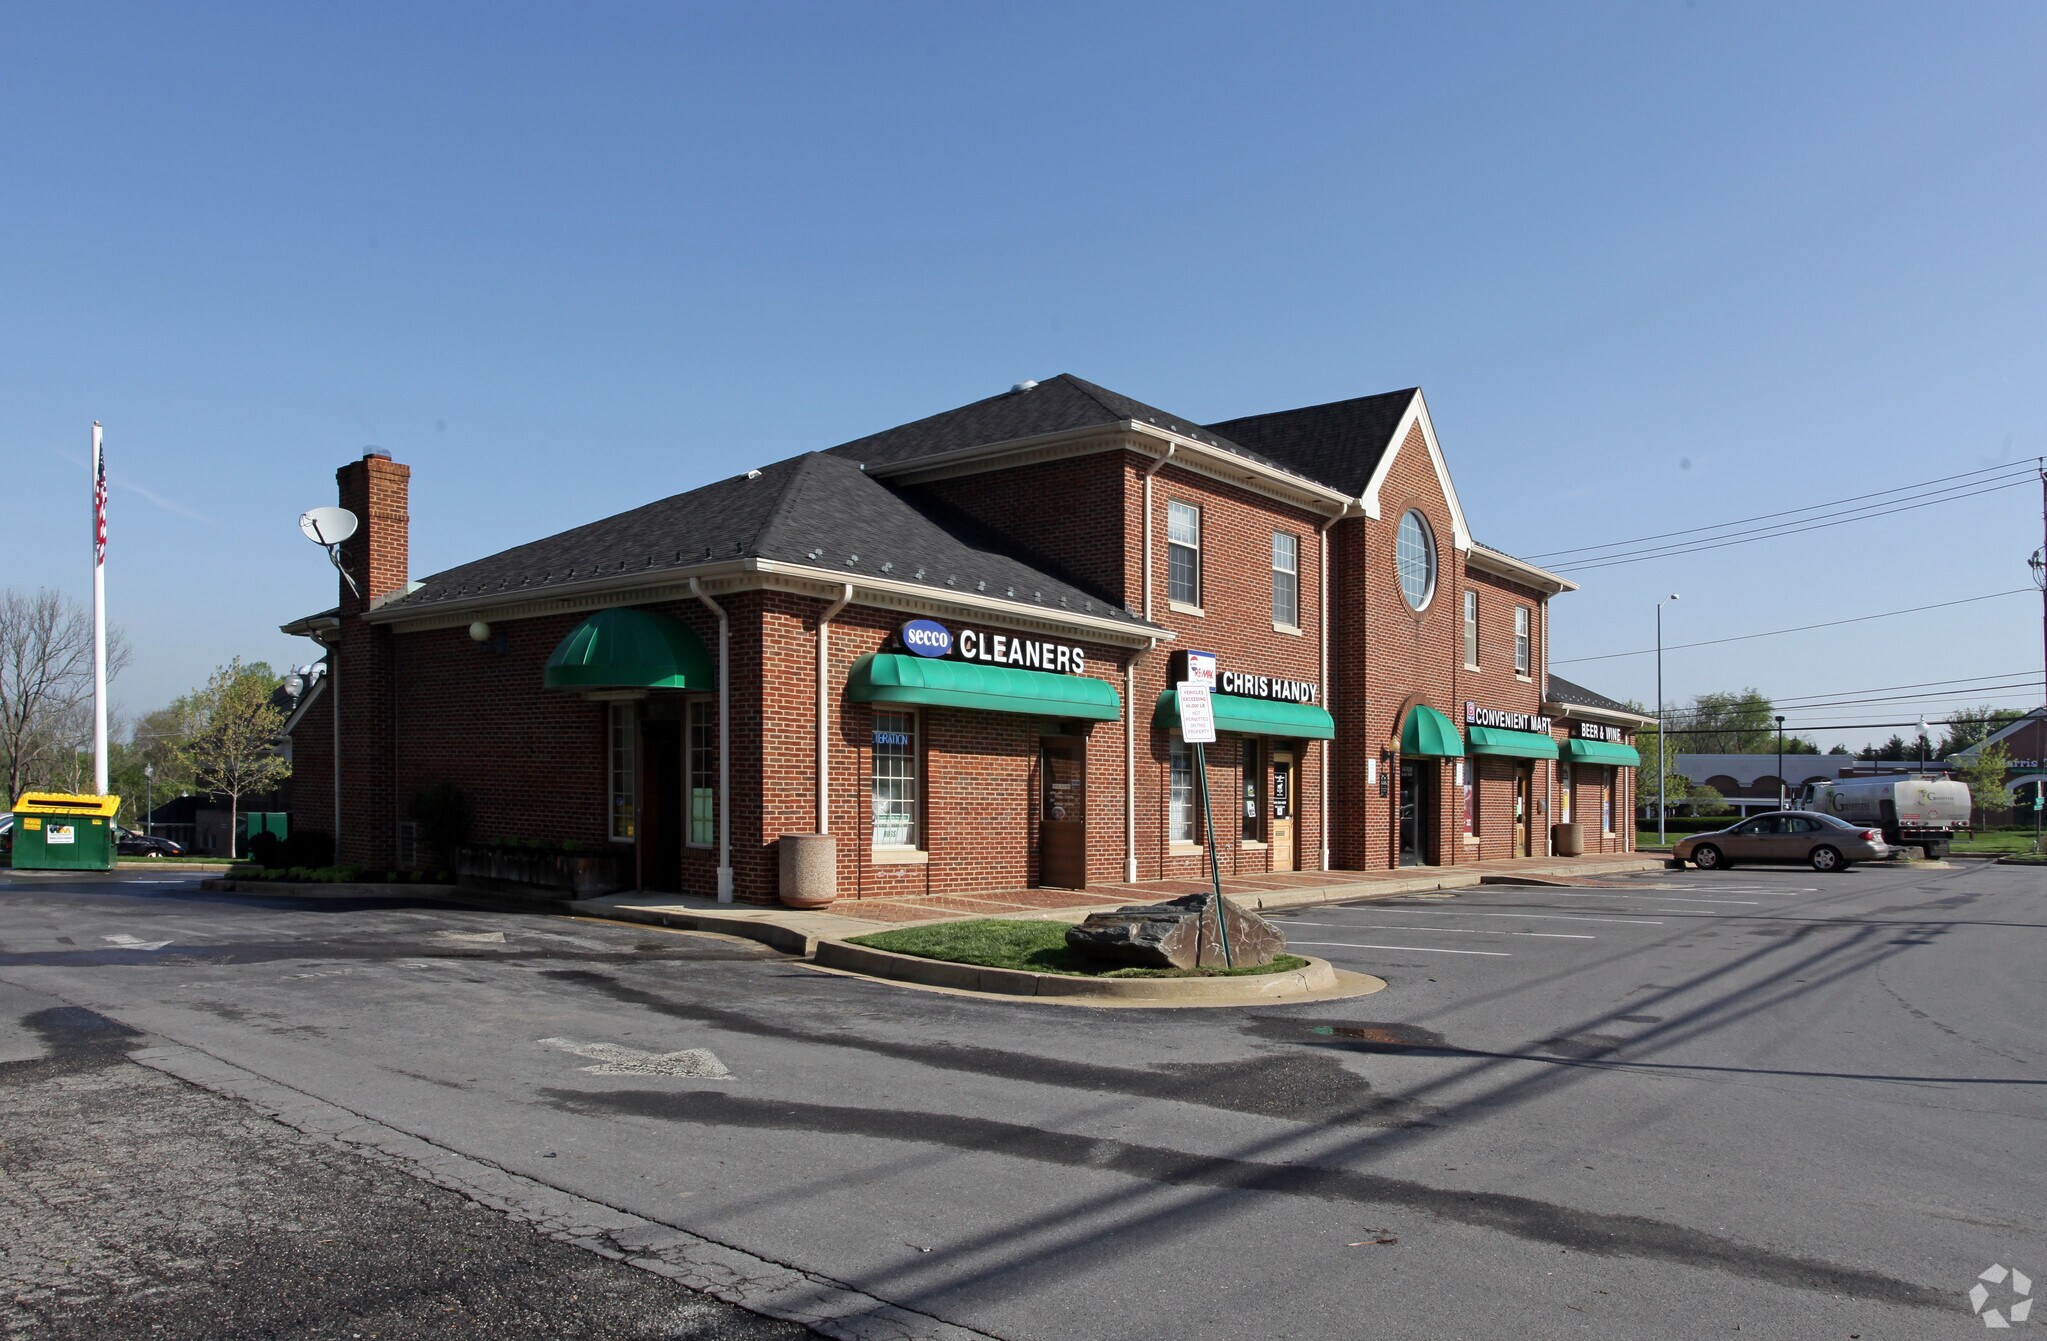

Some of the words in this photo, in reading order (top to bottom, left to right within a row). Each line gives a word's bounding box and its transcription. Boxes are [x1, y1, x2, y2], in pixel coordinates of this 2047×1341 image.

[908, 628, 949, 648] secco
[959, 630, 1085, 674] CLEANERS
[1223, 671, 1268, 697] CHRIS
[1272, 680, 1318, 703] HANDY
[1475, 708, 1529, 730] CONVENIENT
[1530, 715, 1552, 733] MART
[1581, 722, 1599, 739] BEER
[1599, 728, 1604, 740] &
[1605, 727, 1621, 741] WINE
[872, 732, 908, 745] TERATION
